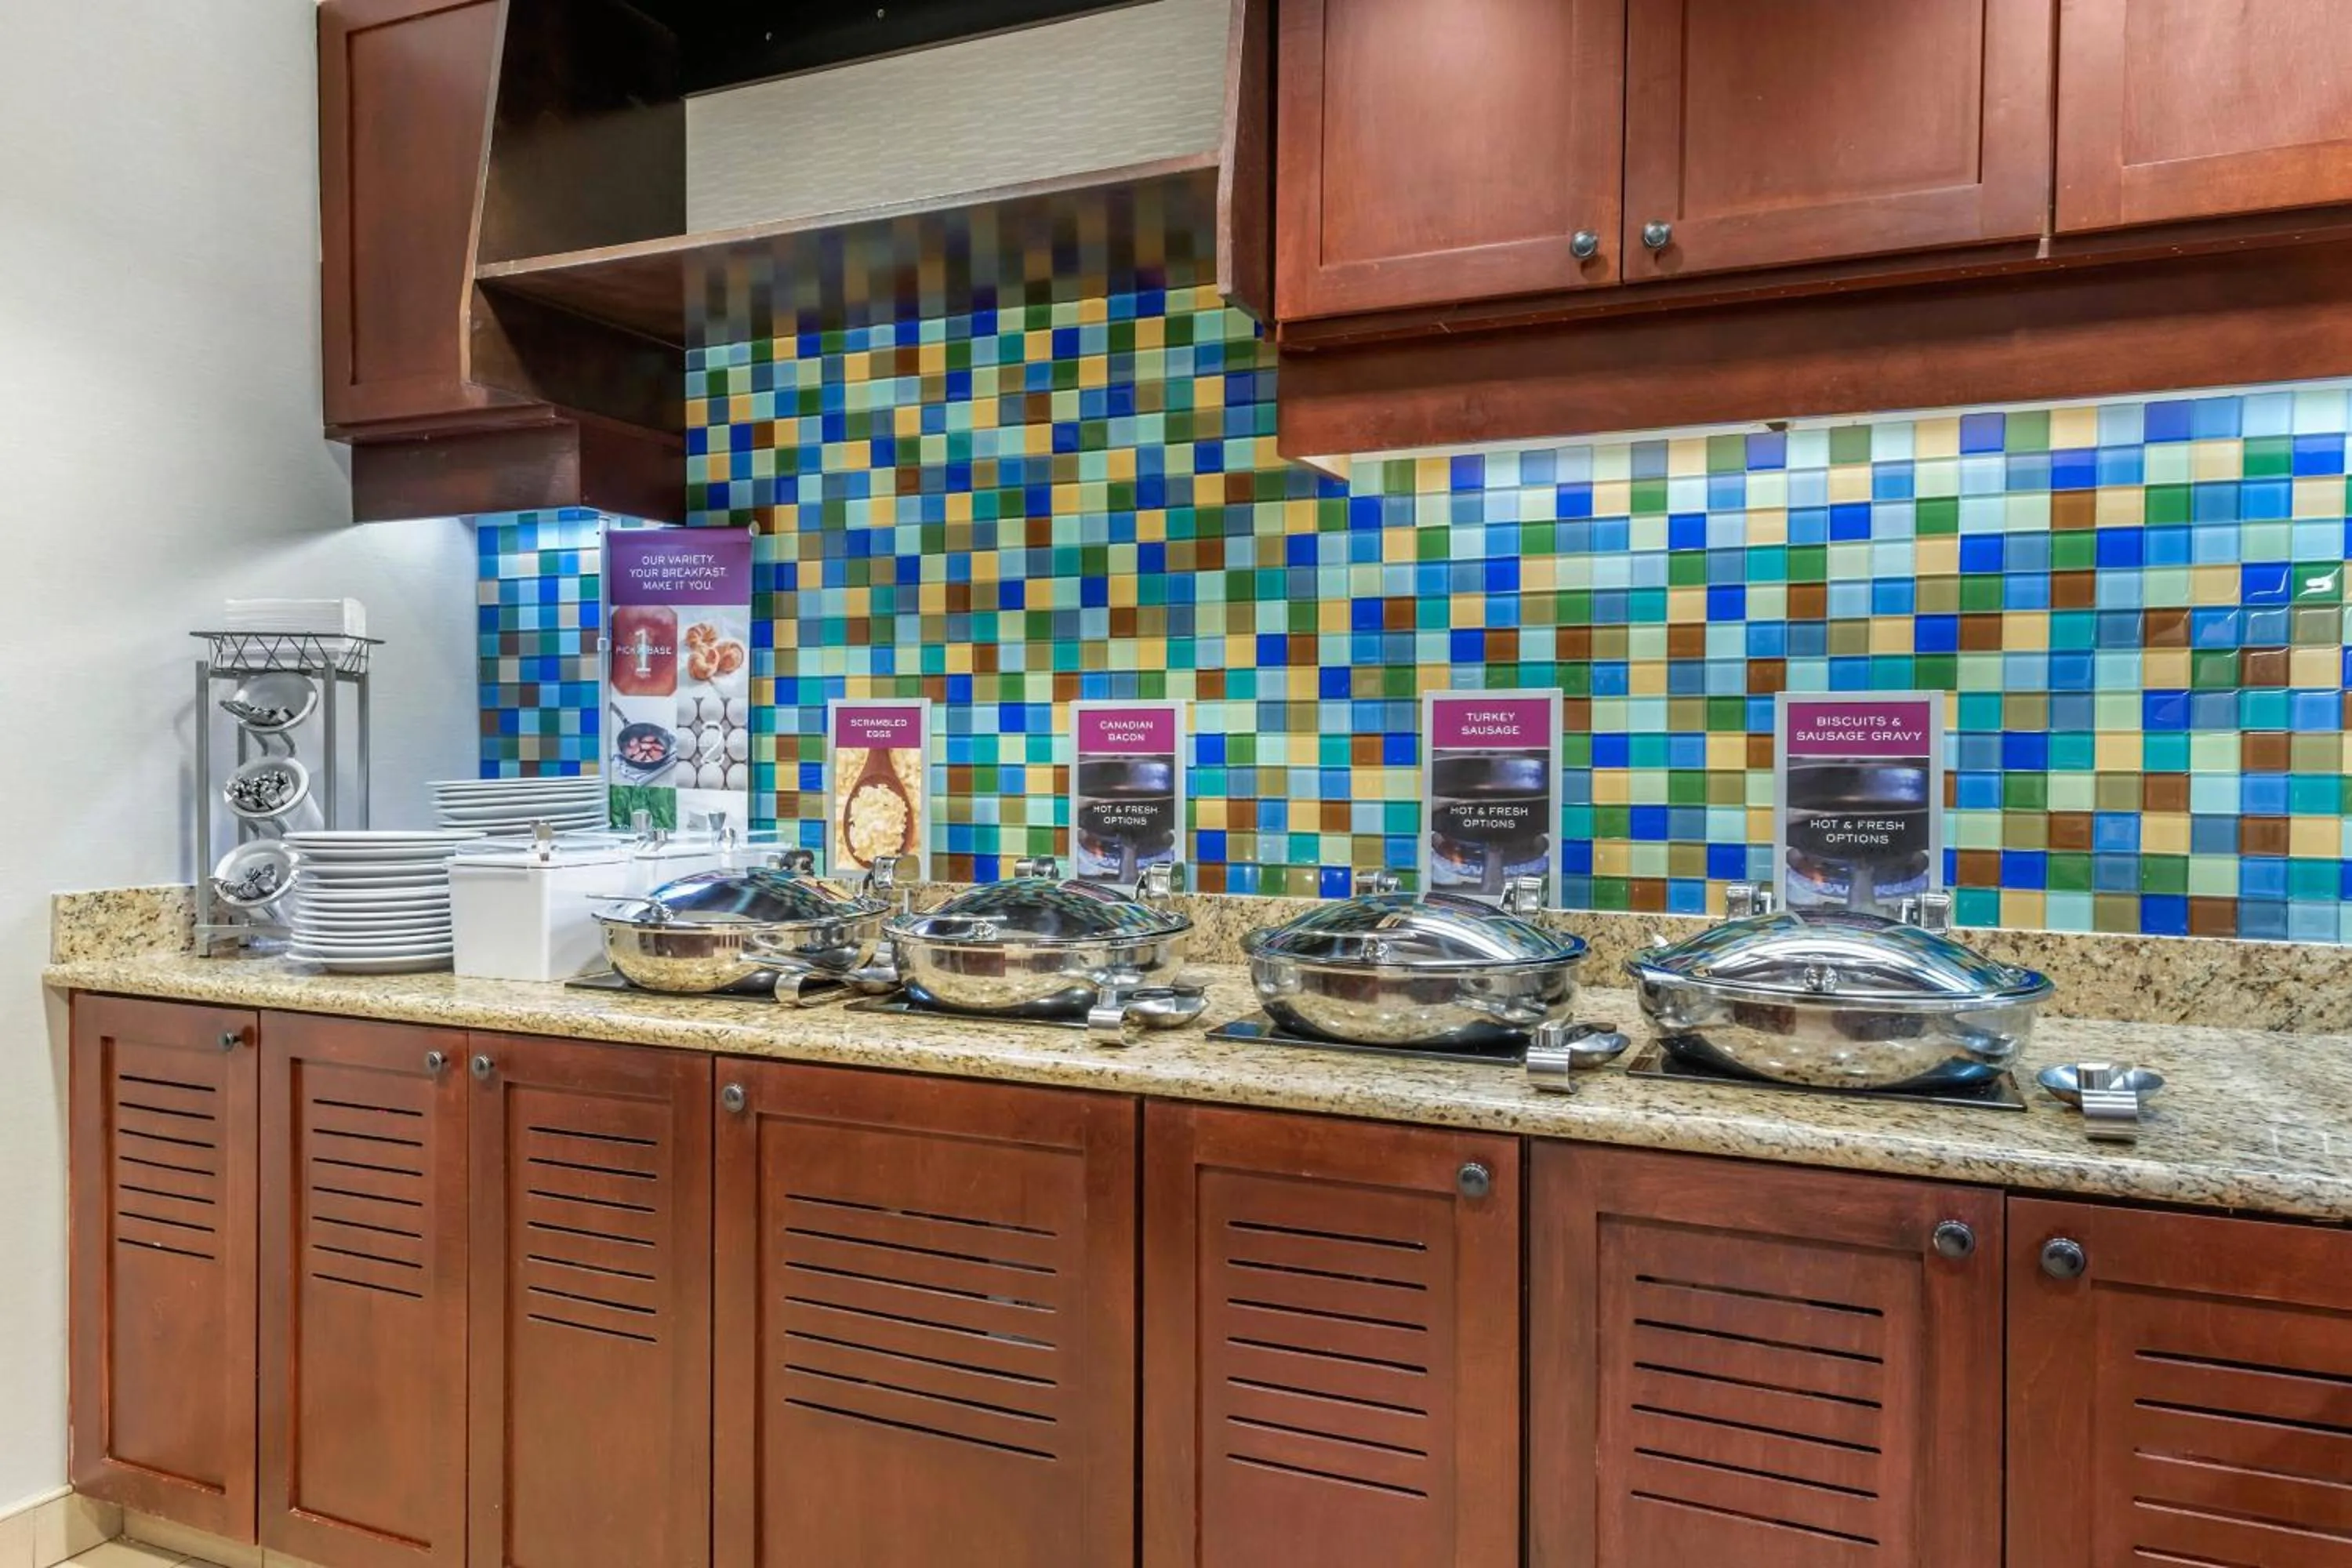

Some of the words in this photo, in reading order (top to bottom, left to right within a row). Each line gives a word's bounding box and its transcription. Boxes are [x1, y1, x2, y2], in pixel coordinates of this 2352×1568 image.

[641, 555, 666, 565] OUR
[630, 568, 659, 578] YOUR
[643, 581, 672, 590] MAKE
[675, 581, 684, 590] IT
[1465, 711, 1515, 721] TURKEY
[850, 718, 907, 728] SCRAMBLED
[1099, 720, 1153, 730] CANADIAN
[1816, 716, 1886, 727] BISCUITS
[1891, 717, 1901, 727] &
[1461, 725, 1521, 735] SAUSAGE
[1108, 733, 1145, 742] BACON
[1795, 731, 1867, 741] SAUSAGE
[1871, 731, 1922, 741] GRAVY
[1115, 805, 1122, 814] &
[1124, 805, 1158, 815] FRESH
[1450, 807, 1473, 815] HOT
[1477, 807, 1484, 815] &
[1489, 807, 1529, 816] FRESH
[1103, 816, 1147, 826] OPTIONS
[1462, 819, 1516, 829] OPTIONS
[1810, 819, 1838, 829] HOT
[1843, 821, 1853, 829] &
[1857, 820, 1905, 830] FRESH
[1826, 833, 1889, 844] OPTIONS
